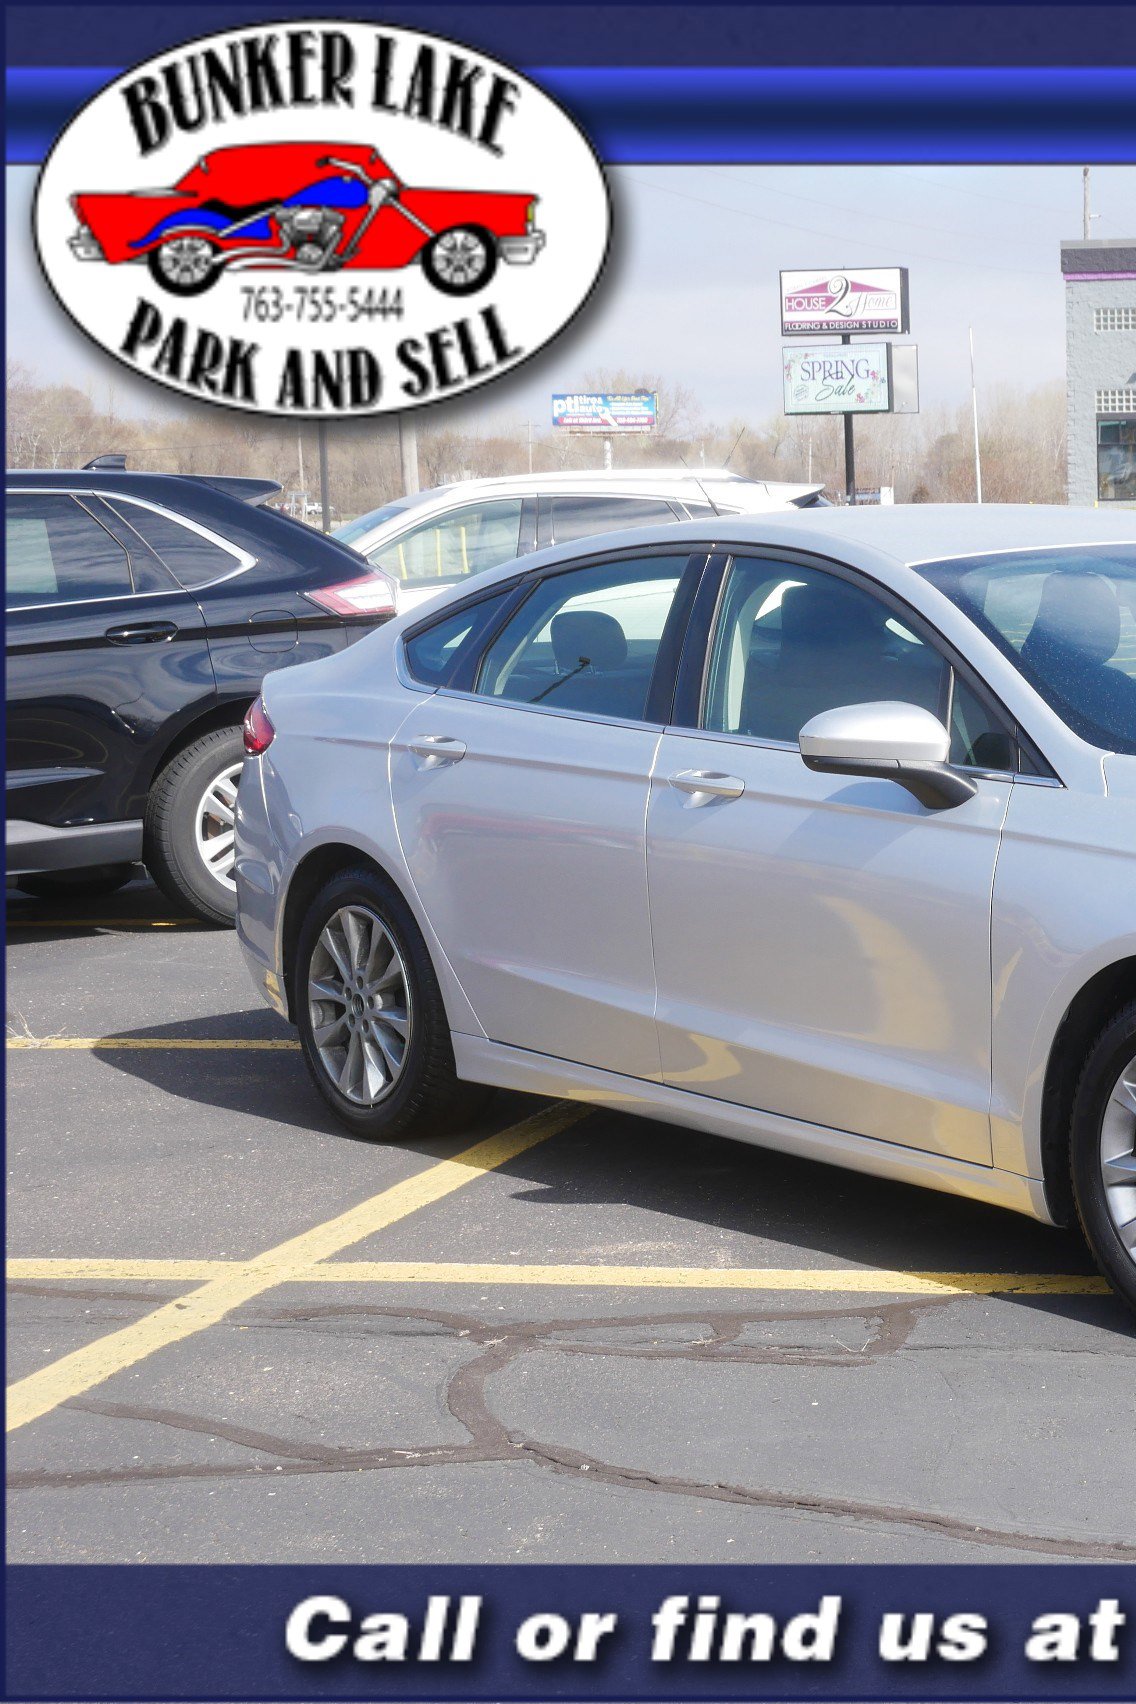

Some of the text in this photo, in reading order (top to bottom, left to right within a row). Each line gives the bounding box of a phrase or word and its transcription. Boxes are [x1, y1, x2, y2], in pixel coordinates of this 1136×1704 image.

[785, 297, 826, 311] HOUSE
[825, 275, 852, 317] 2
[784, 319, 898, 331] FLOORING & DESIGN STUDIO
[800, 358, 870, 381] SPRING
[815, 371, 856, 401] Sale
